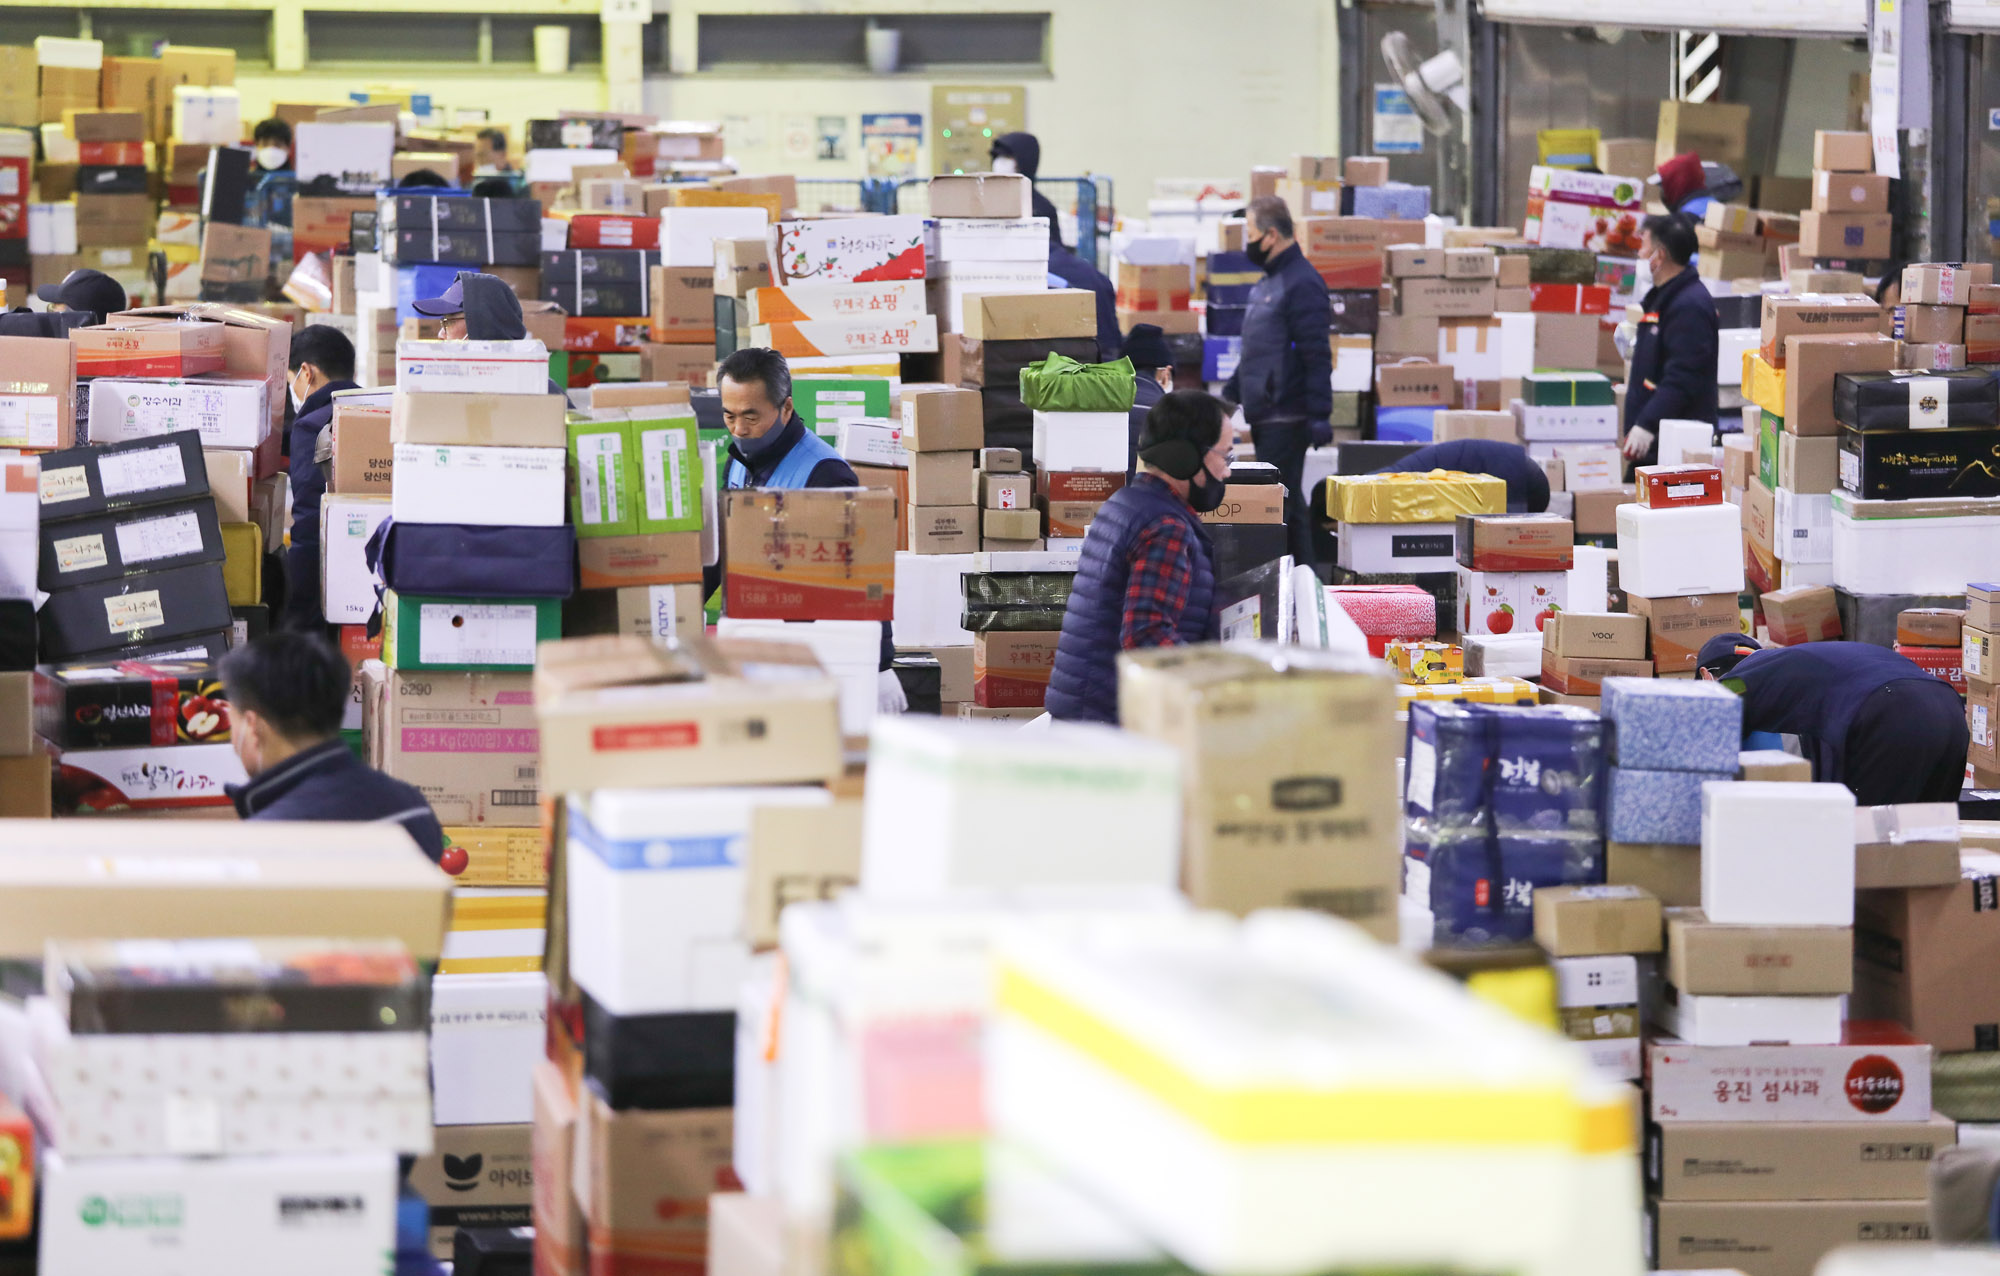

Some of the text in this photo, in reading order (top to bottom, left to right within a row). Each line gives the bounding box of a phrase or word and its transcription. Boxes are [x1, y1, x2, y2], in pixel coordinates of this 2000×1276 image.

[833, 294, 897, 311] 우체국 쇼핑
[1805, 313, 1830, 323] EMS
[845, 329, 909, 346] 우체국 쇼핑
[364, 472, 391, 482] 당신의
[345, 605, 364, 613] 15kg
[1010, 652, 1041, 664] 우체국
[400, 683, 432, 696] 6290
[408, 732, 436, 747] 2.34
[1761, 1080, 1820, 1103] 섬사과
